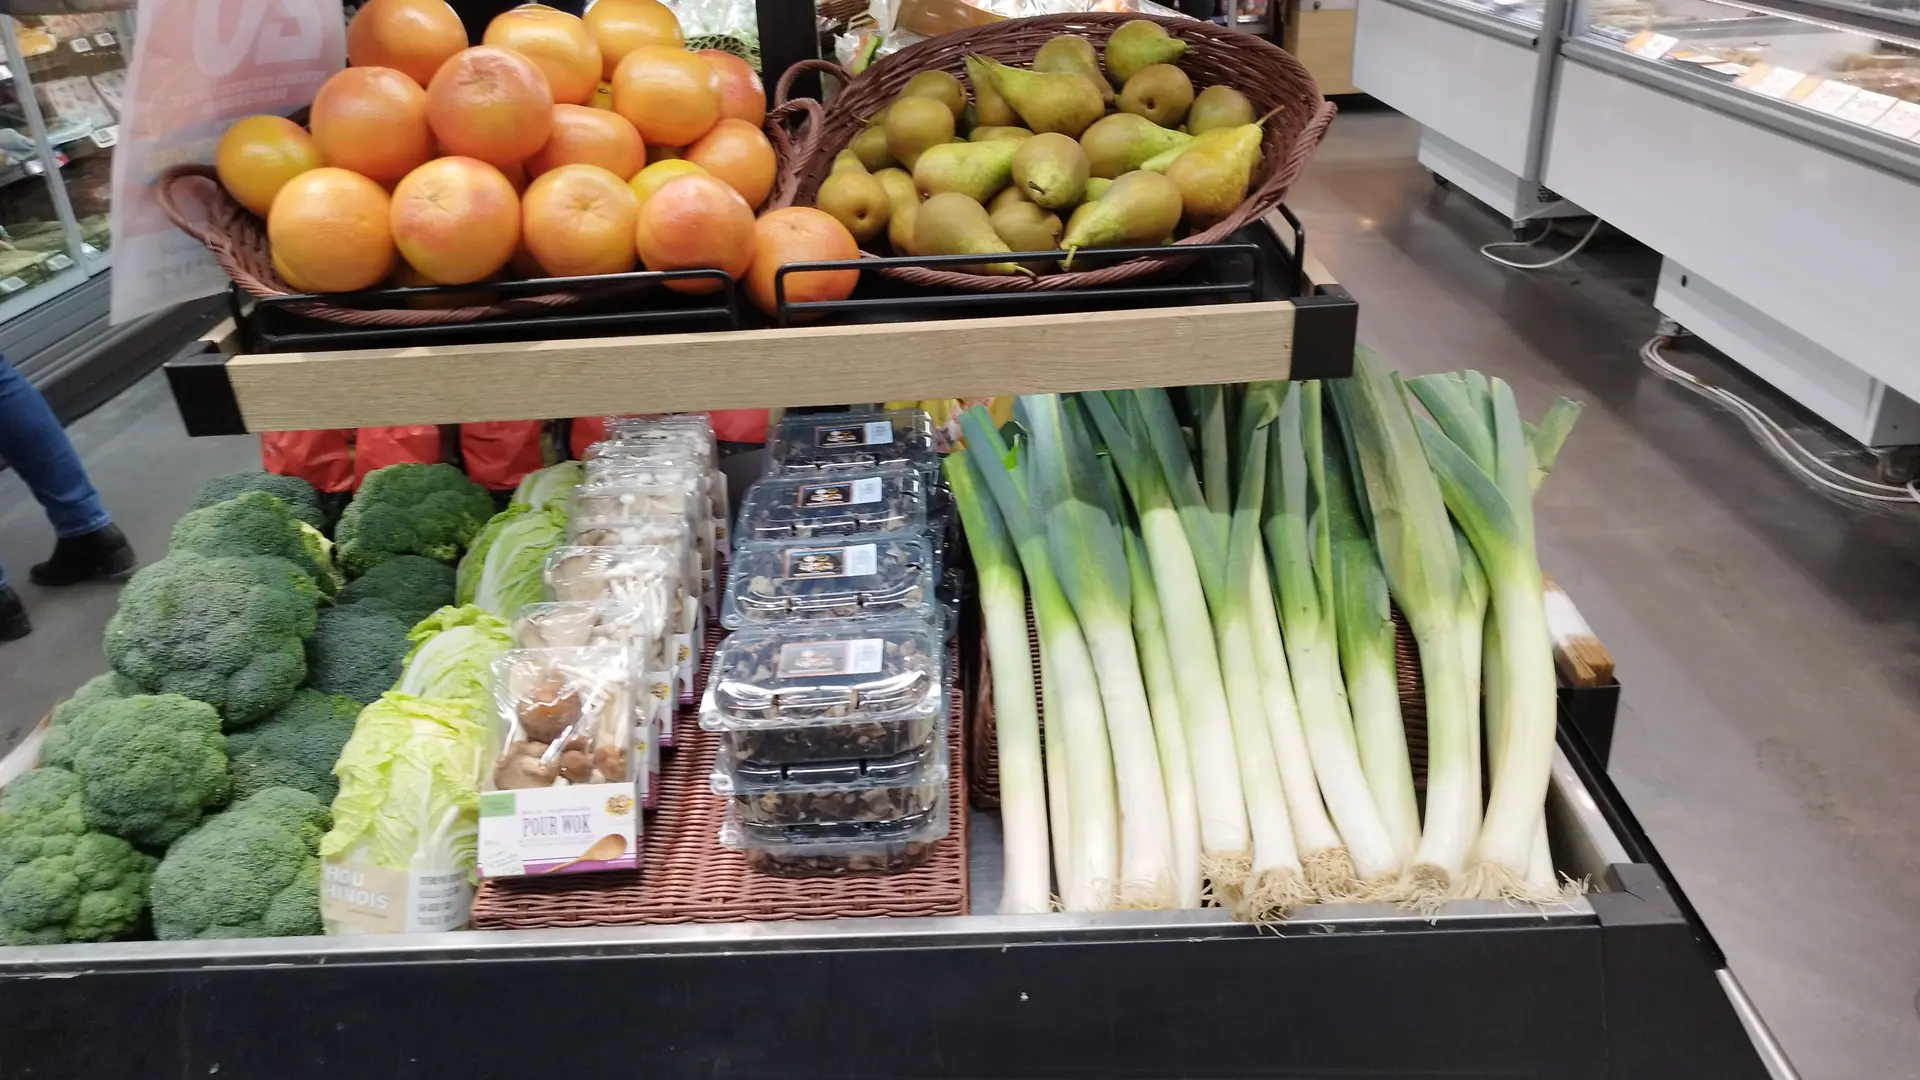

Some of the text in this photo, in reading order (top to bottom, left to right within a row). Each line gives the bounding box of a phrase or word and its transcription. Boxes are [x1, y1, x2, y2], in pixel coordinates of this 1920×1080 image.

[523, 814, 592, 837] POUR WOK
[326, 866, 366, 887] HOU
[327, 884, 389, 910] HINOIS
